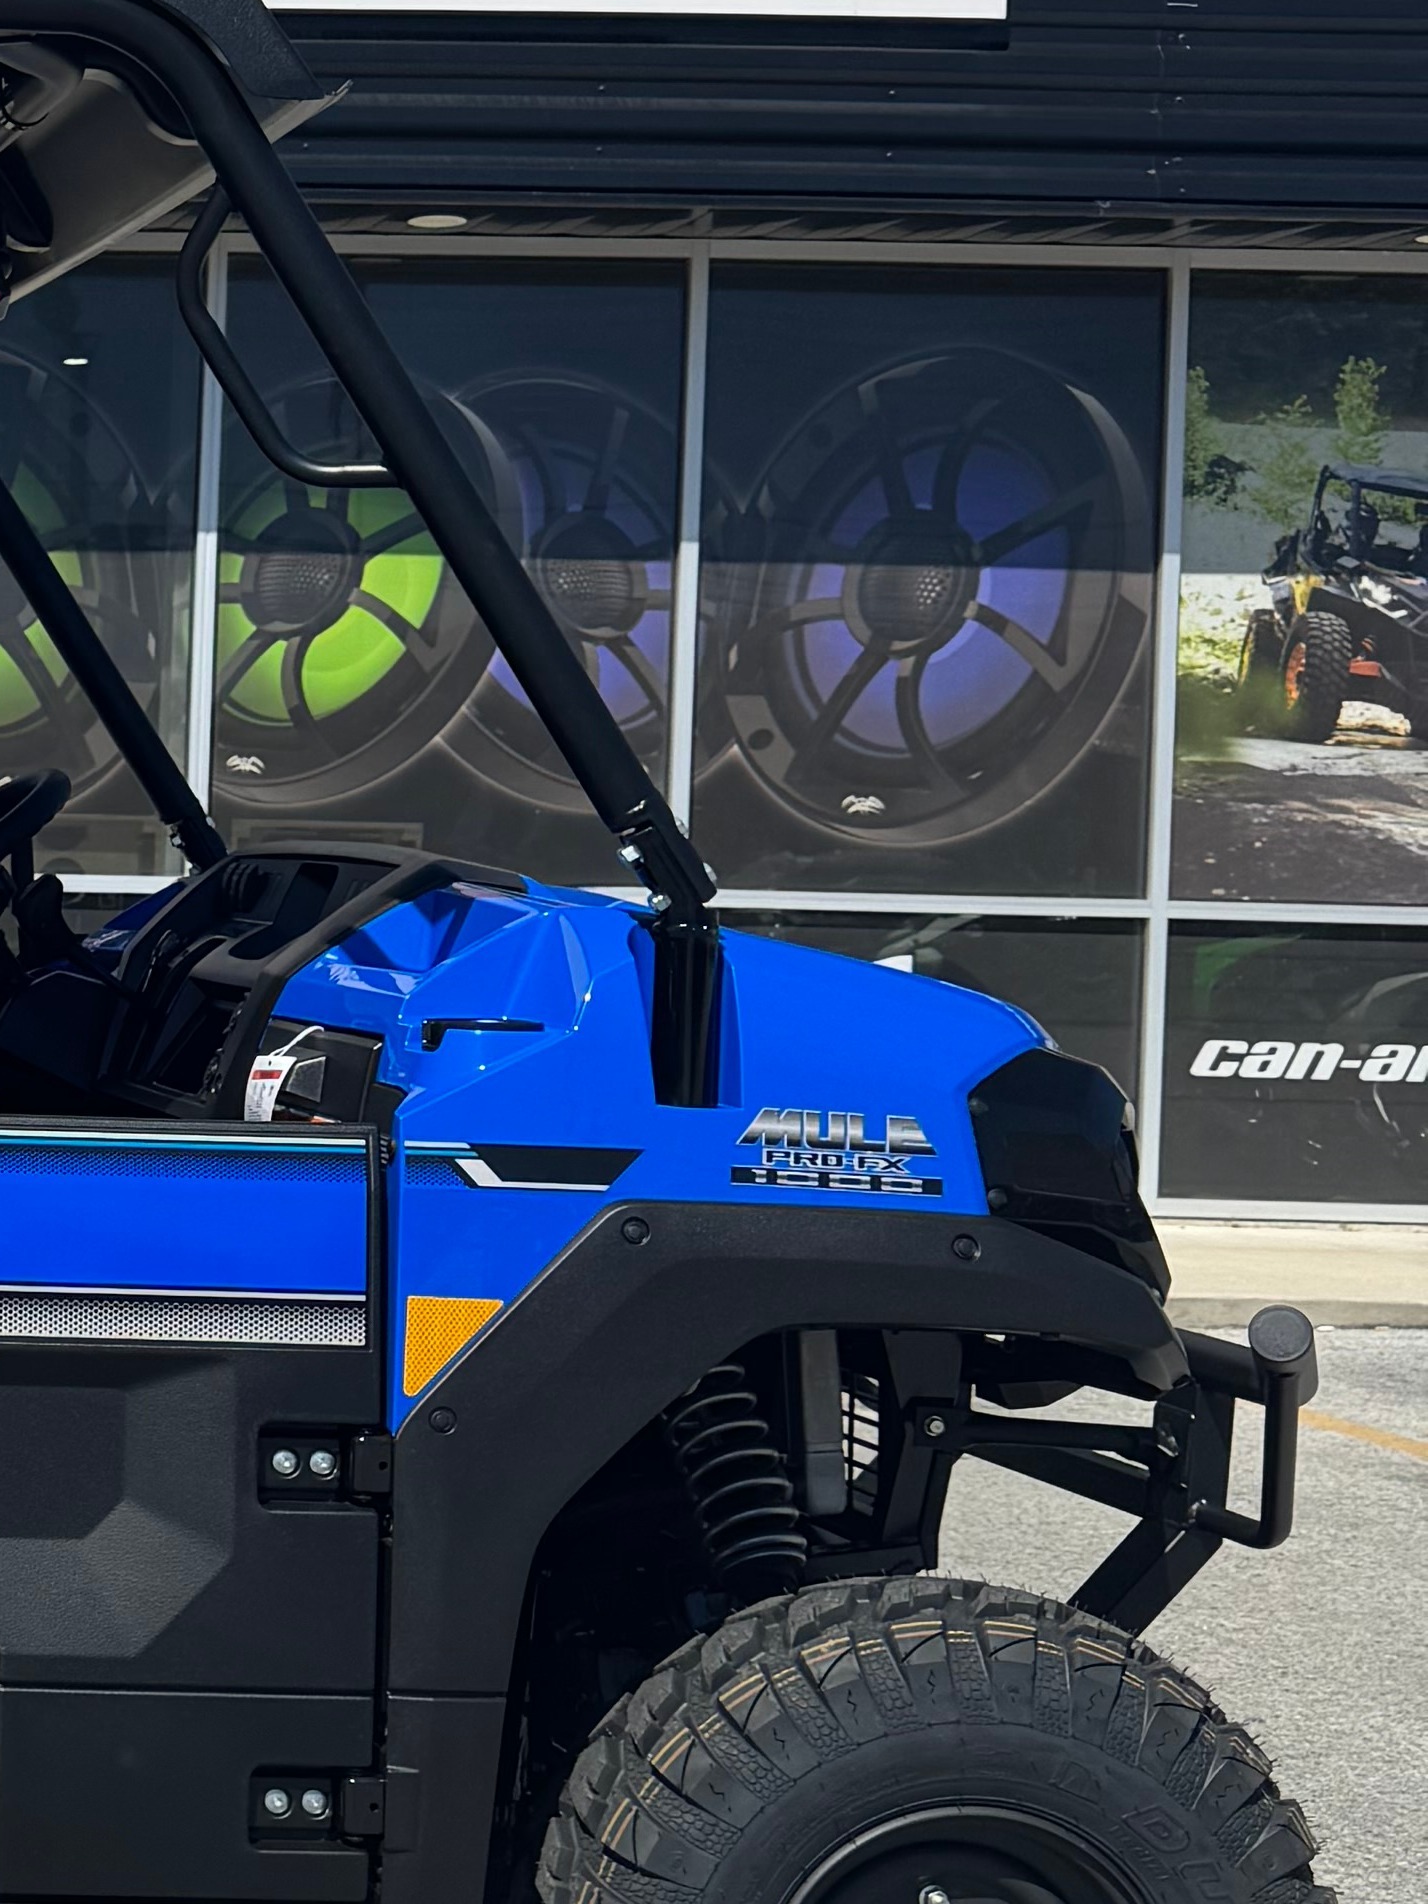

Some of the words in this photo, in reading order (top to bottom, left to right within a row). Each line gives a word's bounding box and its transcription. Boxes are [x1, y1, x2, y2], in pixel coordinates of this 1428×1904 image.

[1189, 1039, 1428, 1082] can-a
[735, 1107, 938, 1157] MULE
[762, 1148, 911, 1174] PRO-FX
[751, 1168, 923, 1193] 1000
